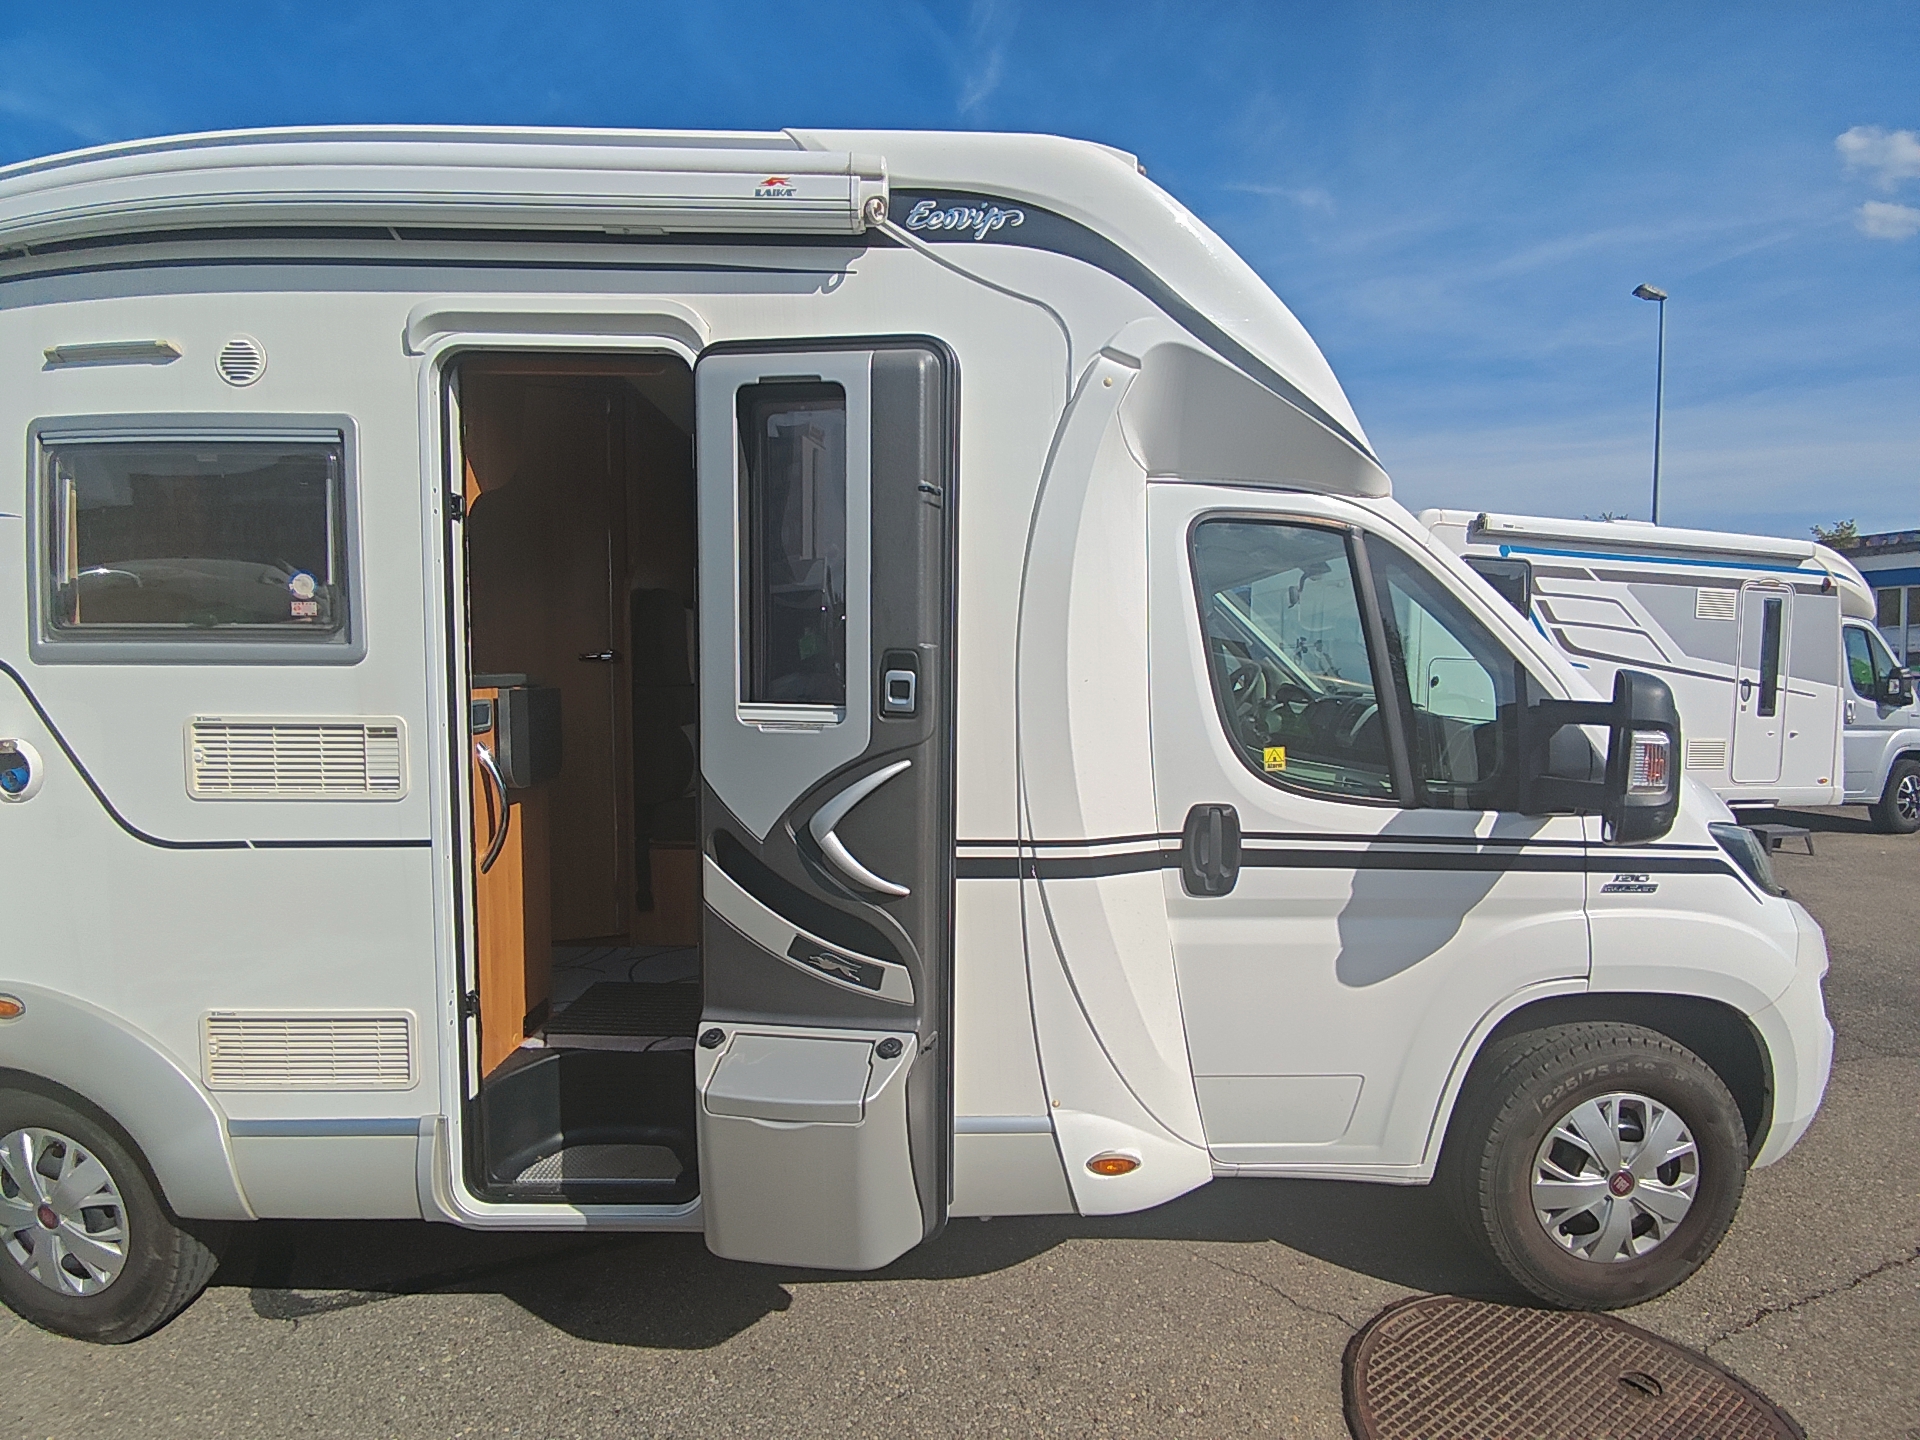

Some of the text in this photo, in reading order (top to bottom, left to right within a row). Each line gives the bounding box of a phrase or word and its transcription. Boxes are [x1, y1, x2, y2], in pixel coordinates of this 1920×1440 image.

[754, 188, 797, 197] LAIKA
[906, 200, 1025, 241] Ecovip
[1541, 1064, 1610, 1109] 225/75
[1613, 1175, 1630, 1192] FIAT
